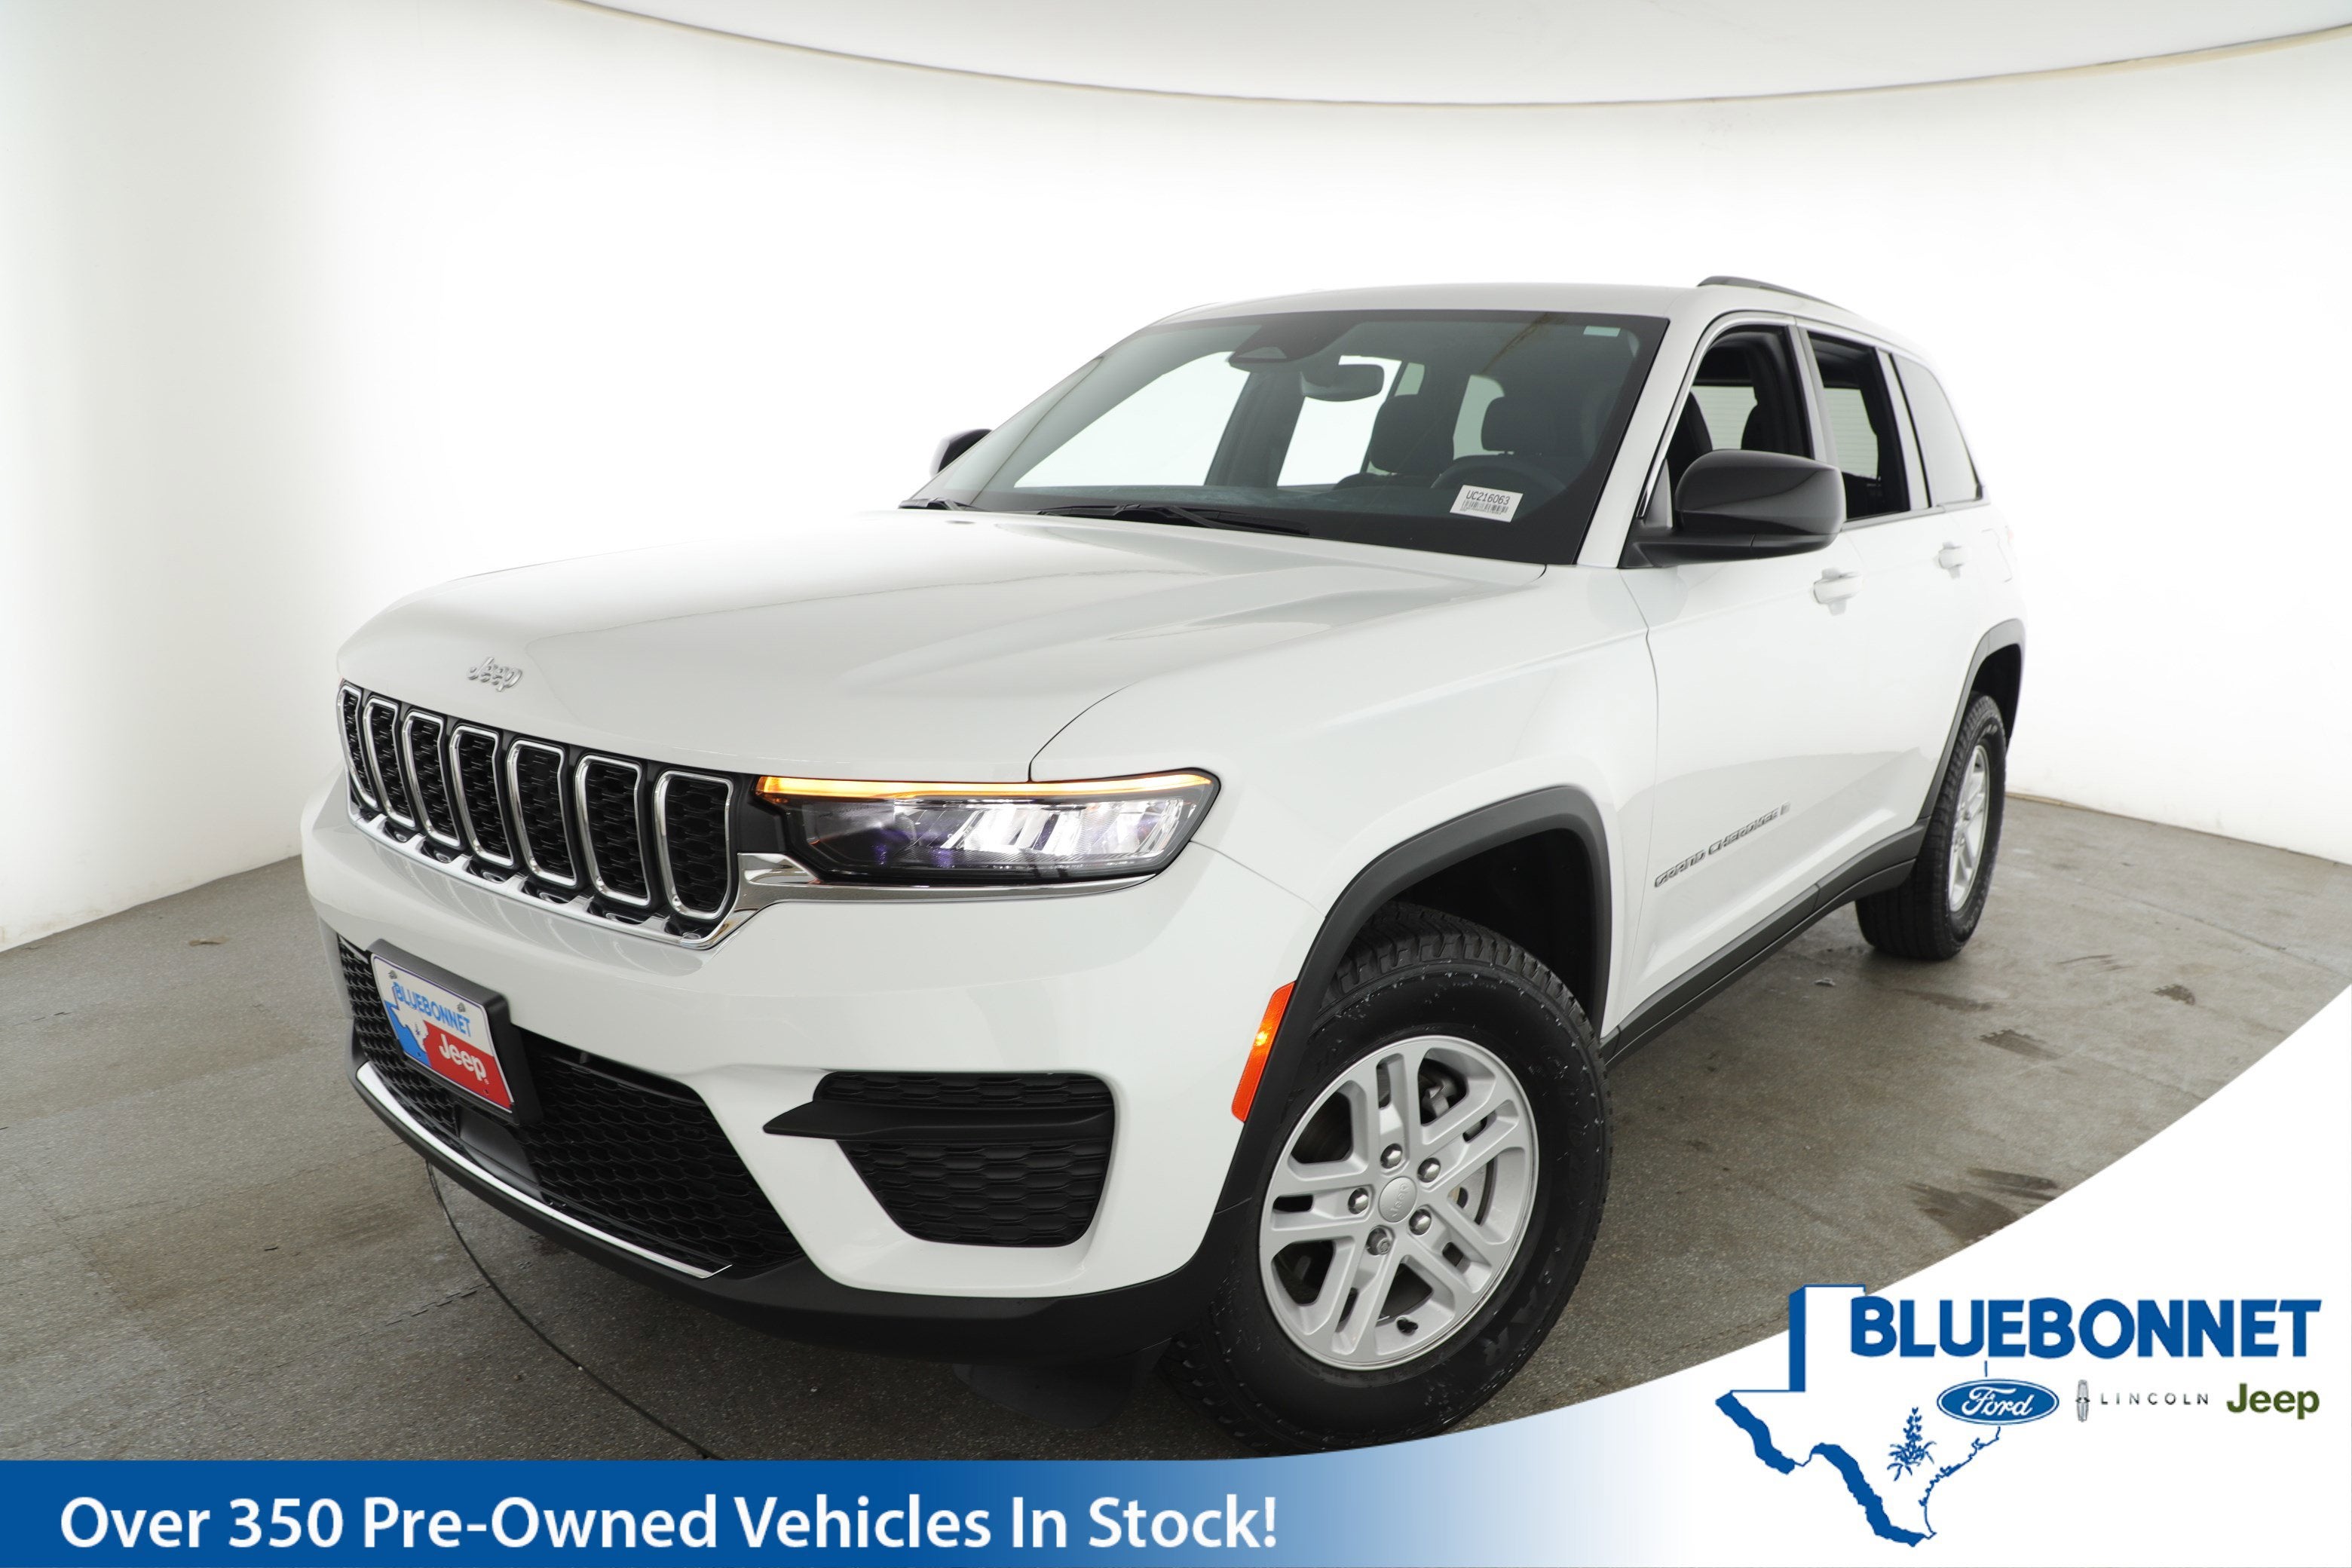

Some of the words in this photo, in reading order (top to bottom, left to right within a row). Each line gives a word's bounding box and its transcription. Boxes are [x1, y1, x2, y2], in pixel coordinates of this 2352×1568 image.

[1465, 490, 1511, 505] UC216063
[467, 656, 523, 693] Jeep
[1654, 850, 1706, 888] GRAND
[1708, 807, 1780, 856] CHEROKEE
[392, 982, 471, 1038] BLUEBONNET
[438, 1033, 487, 1082] Jeep
